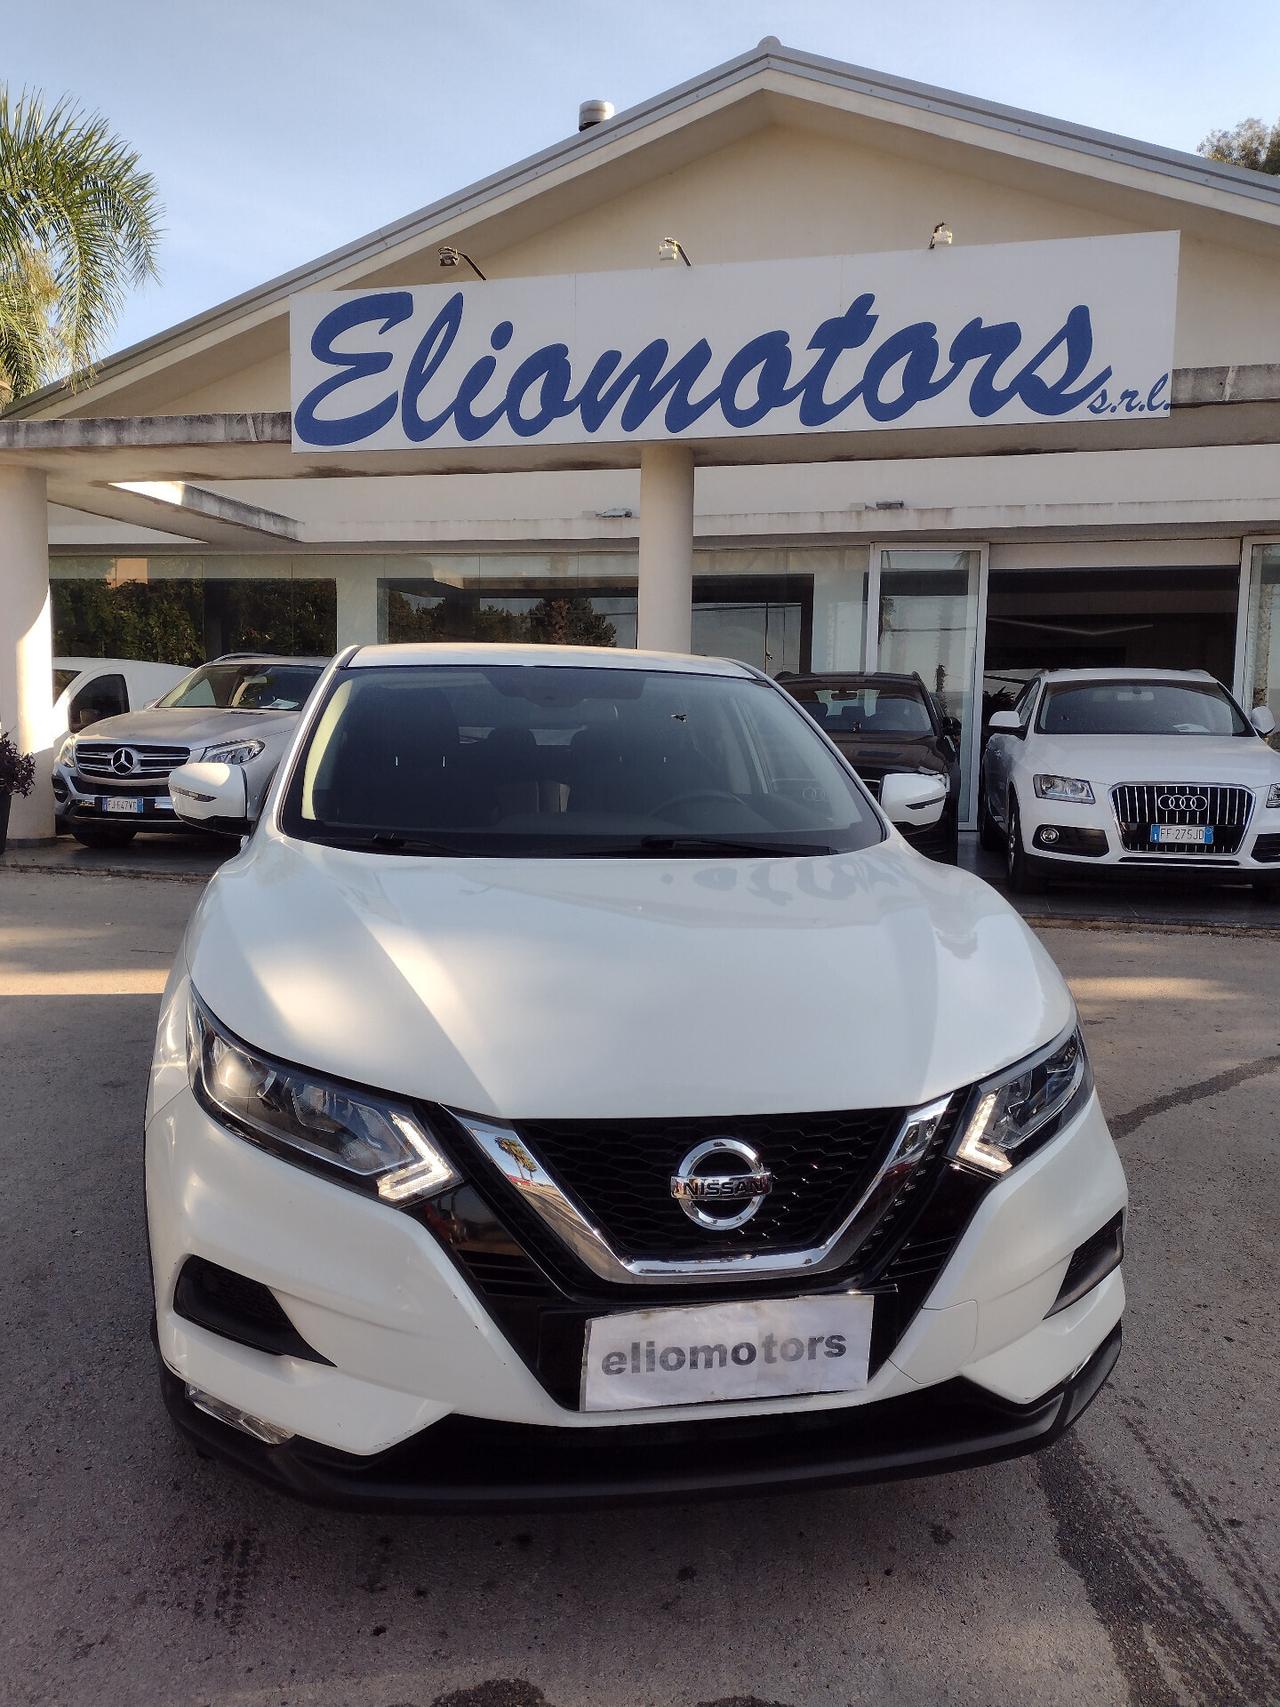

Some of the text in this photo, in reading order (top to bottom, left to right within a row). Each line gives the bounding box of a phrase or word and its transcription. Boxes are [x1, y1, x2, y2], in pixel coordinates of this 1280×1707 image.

[294, 292, 1170, 446] Eliomotors s.r.l.
[682, 1178, 765, 1197] NISSAN
[602, 1334, 847, 1376] eliomotors
